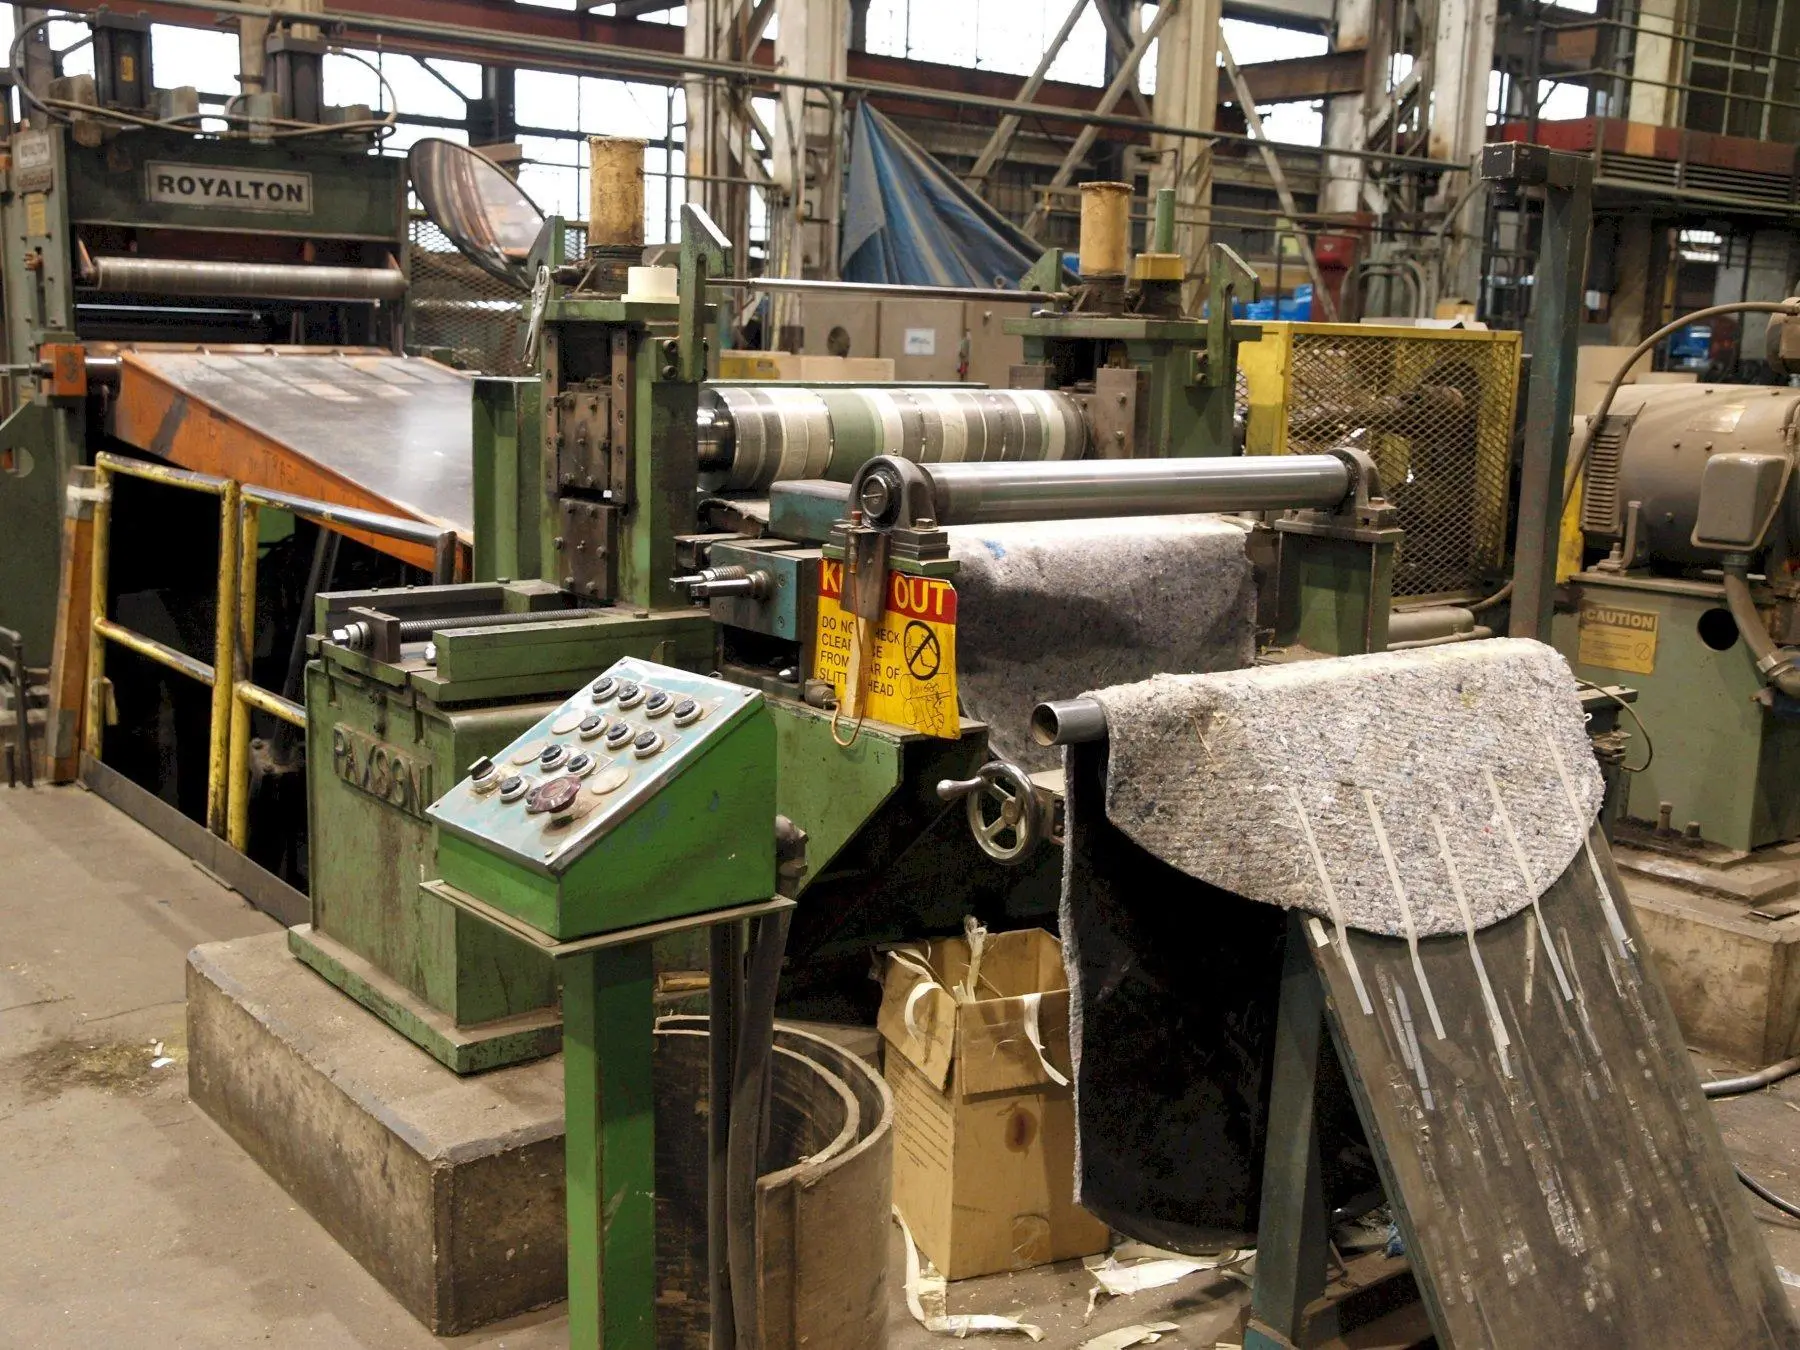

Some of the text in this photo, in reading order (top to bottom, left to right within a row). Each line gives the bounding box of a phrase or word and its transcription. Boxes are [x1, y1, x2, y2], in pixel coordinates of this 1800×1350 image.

[157, 174, 303, 202] ROYALTON
[894, 575, 950, 615] OUT
[822, 616, 900, 644] DO NO HECK
[1586, 610, 1655, 629] CAUTION
[886, 666, 900, 679] OF
[867, 680, 894, 697] HEAD
